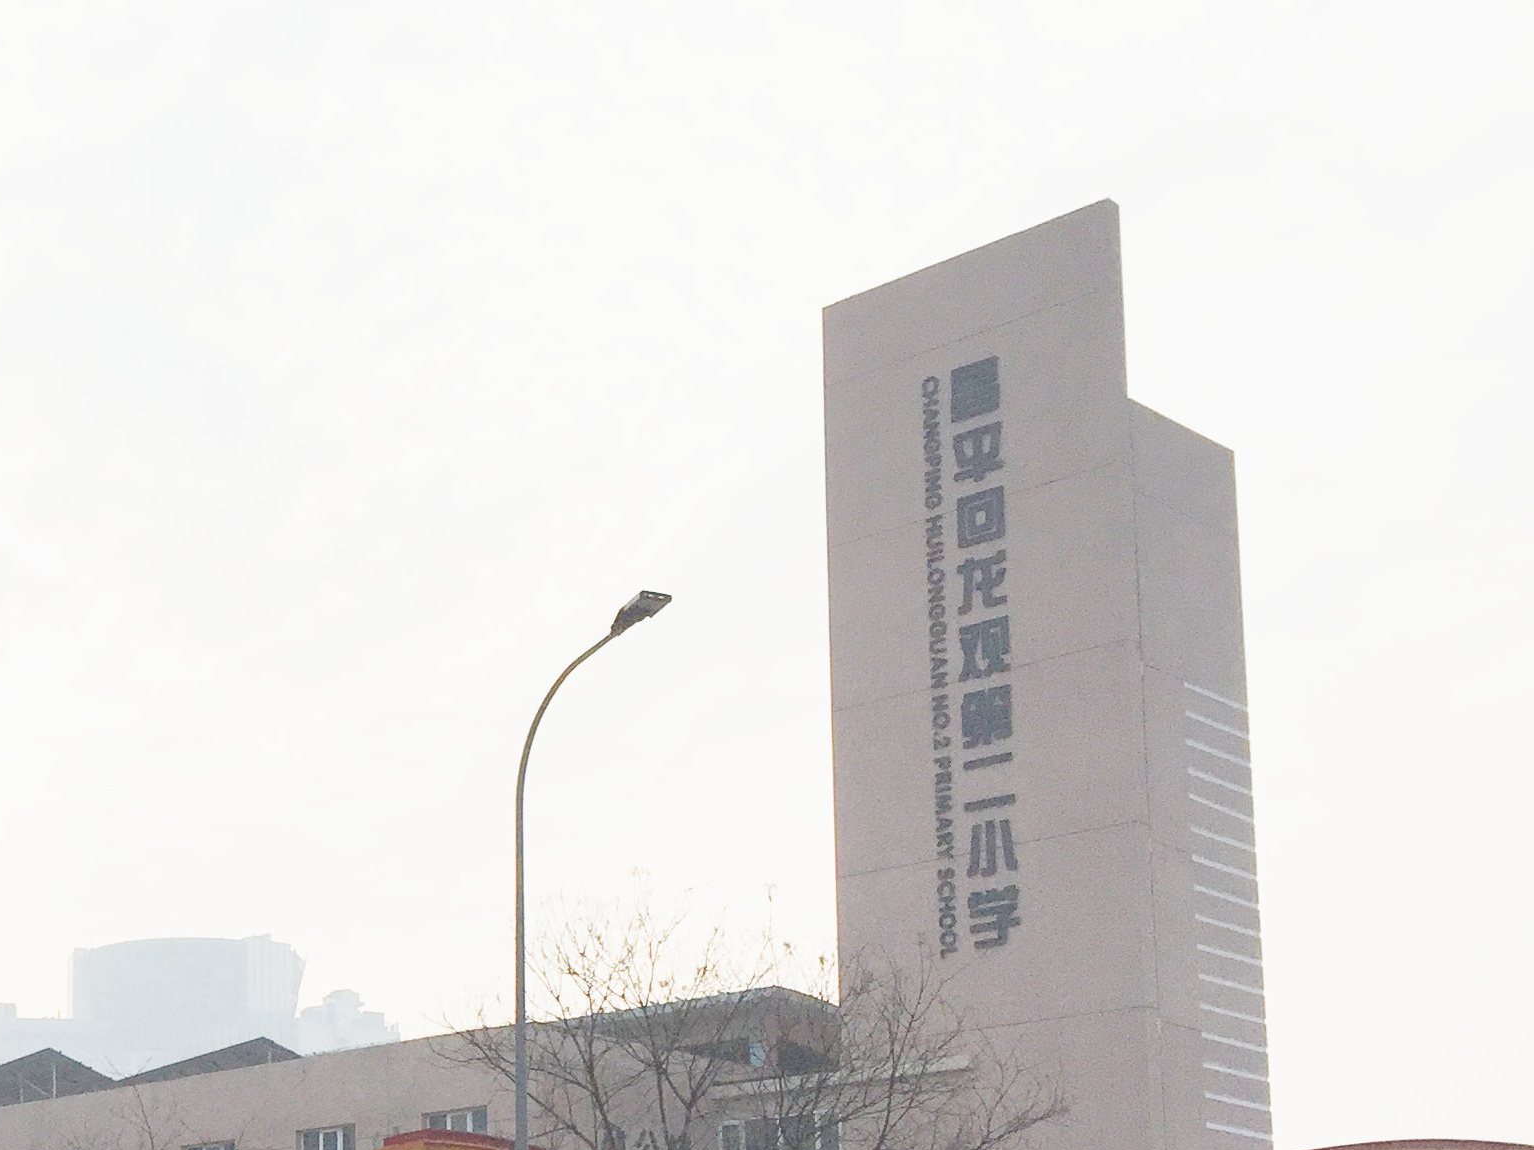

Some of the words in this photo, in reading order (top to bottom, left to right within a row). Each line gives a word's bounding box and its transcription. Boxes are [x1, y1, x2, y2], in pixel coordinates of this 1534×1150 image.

[921, 375, 943, 511] CHANGPING
[925, 513, 948, 690] HUILONGGUAN
[950, 355, 1021, 950] 昌平回龙观第二小学
[931, 694, 951, 750] NO.2
[933, 756, 954, 859] PRIMARY
[936, 867, 958, 959] SCHOOL
